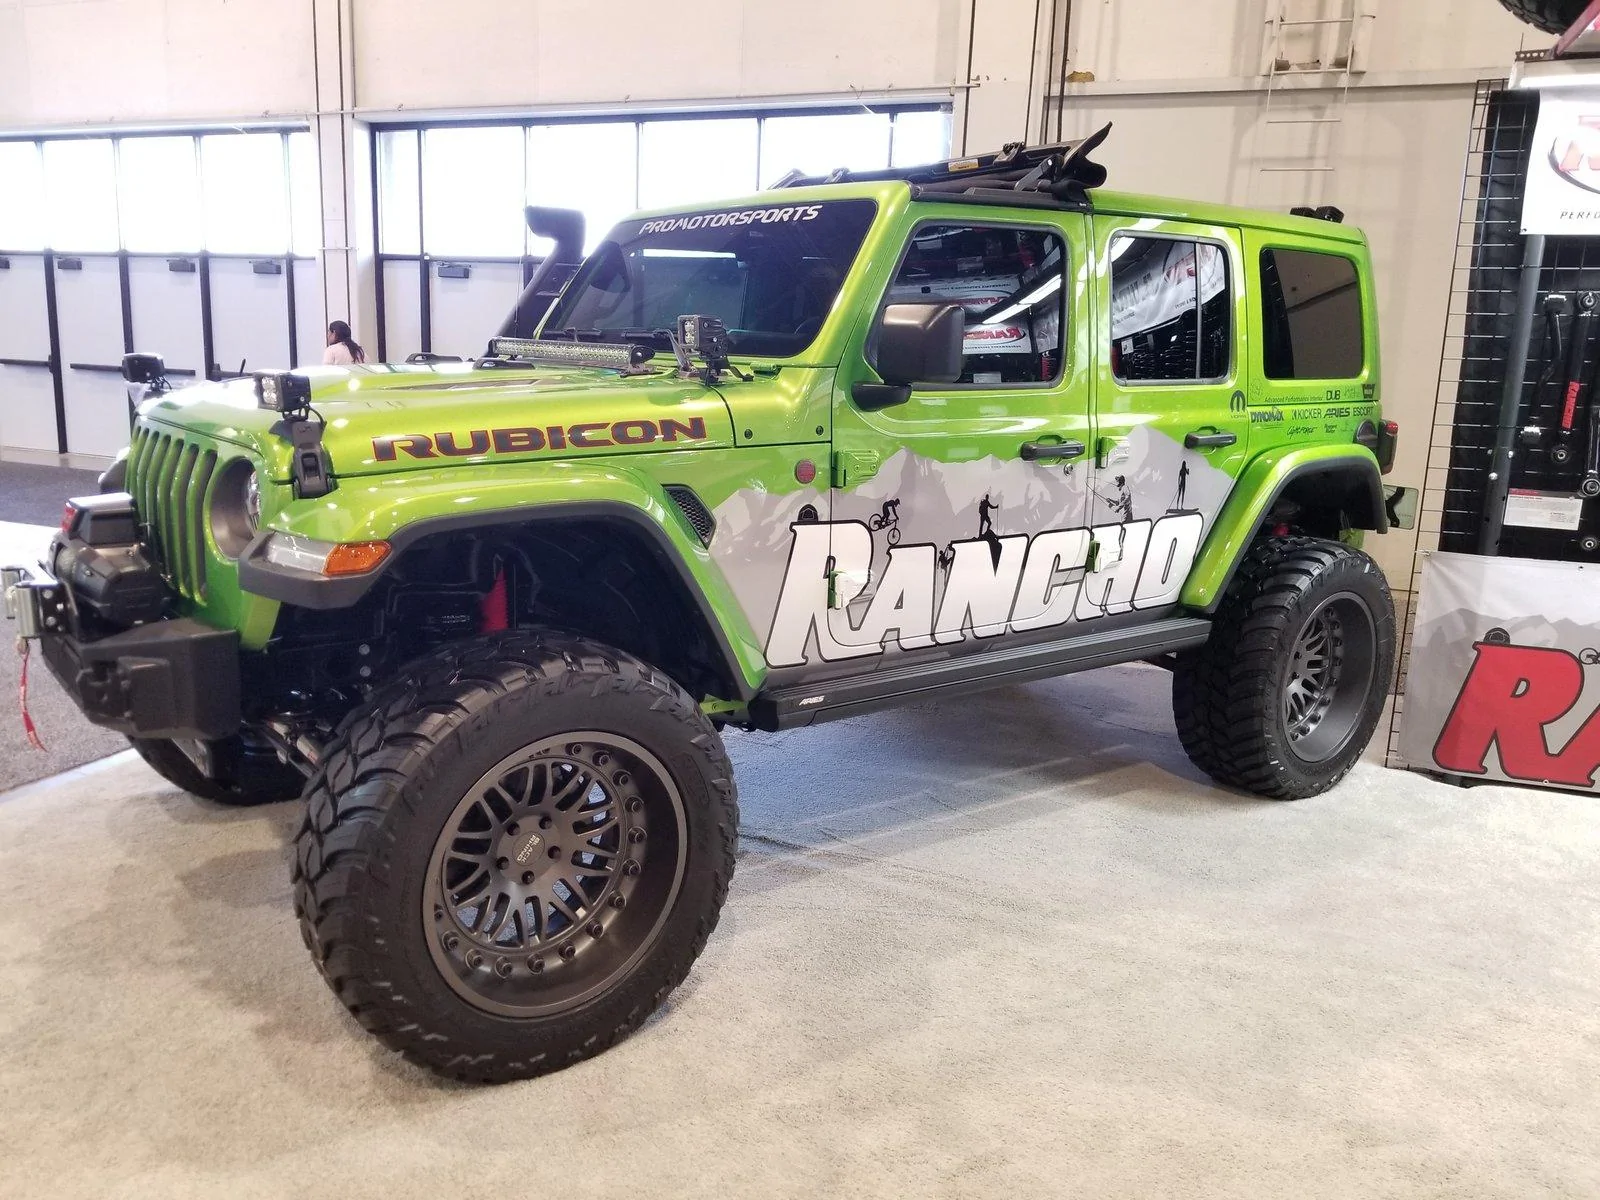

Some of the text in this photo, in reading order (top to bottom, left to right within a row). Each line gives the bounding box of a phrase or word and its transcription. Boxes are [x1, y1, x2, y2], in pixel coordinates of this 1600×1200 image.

[639, 204, 823, 235] PROMOTORSPORTS
[1323, 407, 1350, 418] ARIES
[1352, 406, 1374, 417] ESCORT
[1326, 389, 1341, 400] DUB
[371, 416, 707, 462] RUBICON
[765, 511, 1205, 668] RANCHO
[1432, 640, 1600, 788] R
